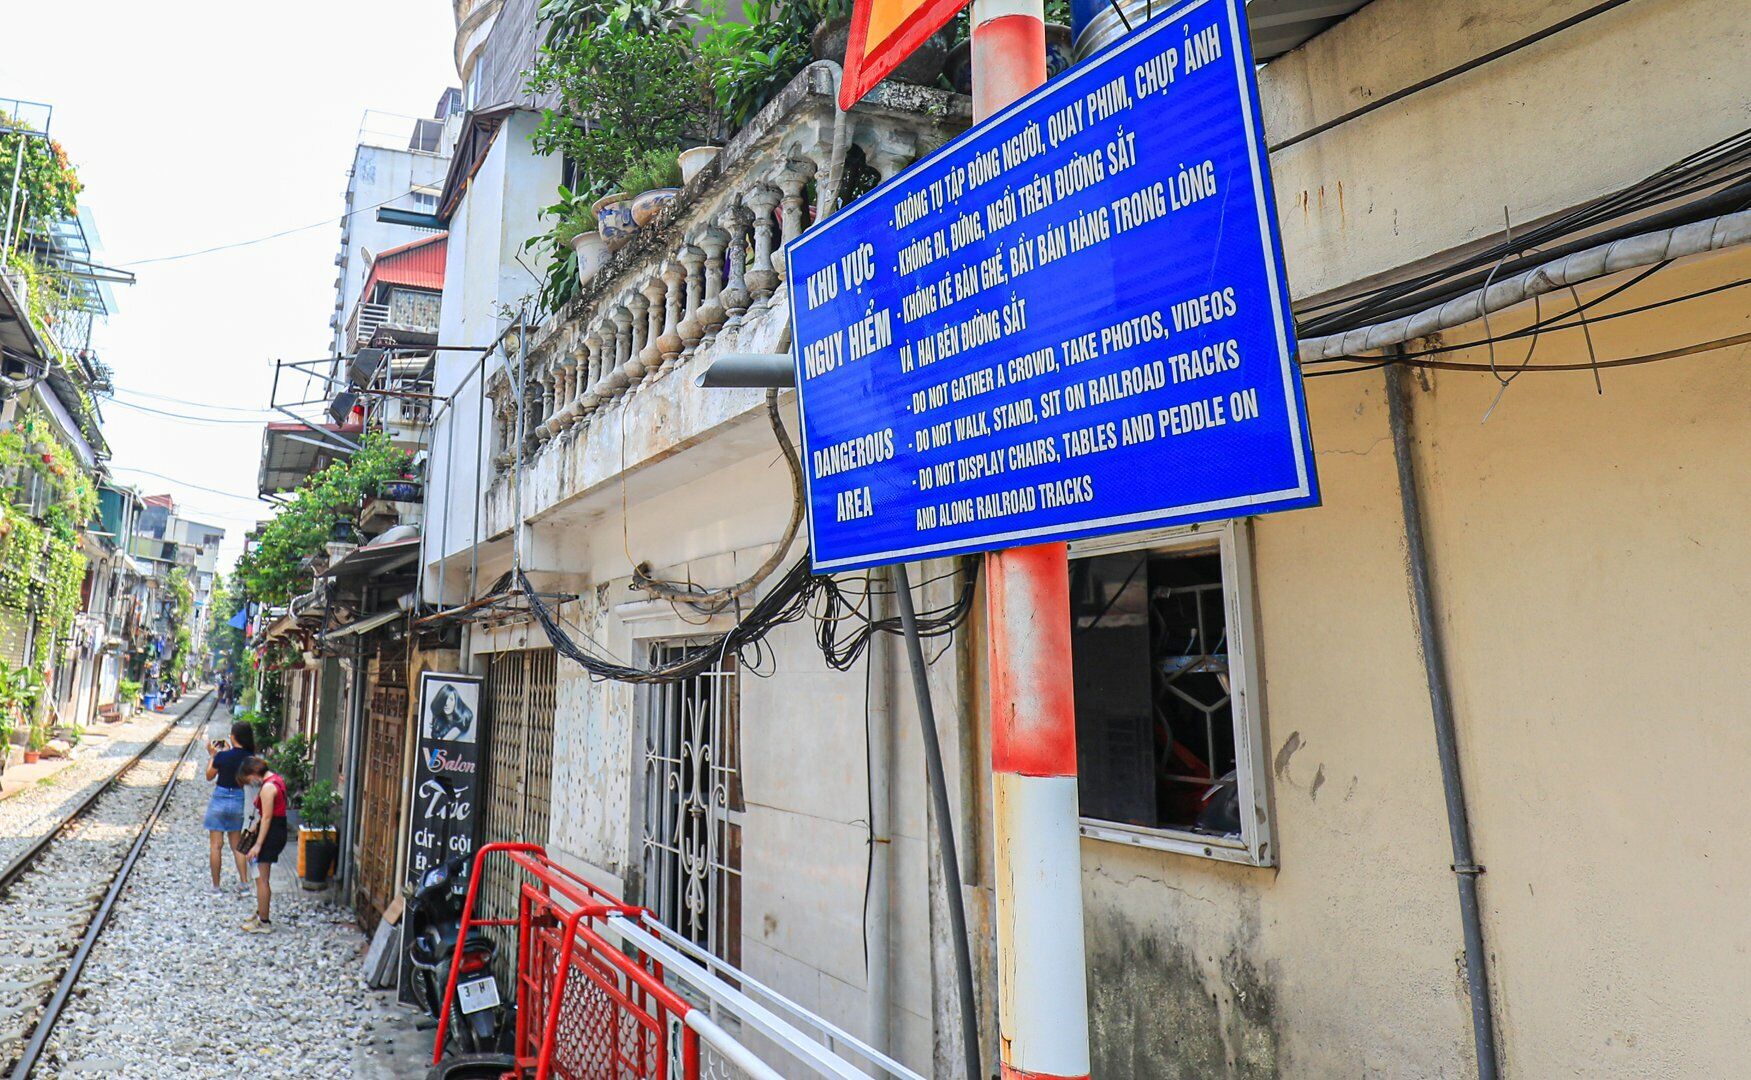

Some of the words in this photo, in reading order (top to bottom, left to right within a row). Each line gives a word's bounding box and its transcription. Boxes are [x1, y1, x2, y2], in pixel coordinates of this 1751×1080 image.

[894, 188, 929, 231] KHÔNG
[929, 179, 944, 214] TỤ
[944, 165, 966, 206] TẬP
[967, 147, 1001, 191] ĐÔNG
[1001, 119, 1046, 172] NGƯỜI,
[1047, 98, 1084, 149] QUAY
[1086, 75, 1133, 126] PHIM,
[1134, 47, 1178, 100] CHỤP
[1183, 22, 1222, 75] ẢNH
[898, 235, 933, 278] KHÔNG
[933, 228, 950, 260] ĐI,
[950, 210, 986, 252] ĐỨNG,
[986, 184, 1017, 234] NGỒI
[1017, 173, 1054, 218] TRÊN
[1054, 149, 1105, 201] ĐƯỜNG
[1106, 124, 1136, 176] SẮT
[902, 283, 938, 324] KHÔNG
[938, 271, 954, 309] KÊ
[954, 263, 979, 302] BÀN
[980, 242, 1009, 291] GHẾ,
[1009, 232, 1034, 278] BẦY
[1036, 223, 1067, 267] BÁN
[1068, 206, 1111, 254] HÀNG
[1111, 181, 1167, 234] TRONG
[1168, 159, 1217, 212] LÒNG
[806, 262, 839, 311] KHU
[841, 242, 875, 295] VỰC
[803, 329, 844, 381] NGUY
[848, 298, 892, 362] HIỂM
[899, 338, 914, 374] VÀ
[917, 335, 936, 368] HAI
[936, 322, 960, 361] BÊN
[960, 308, 1001, 352] ĐƯỜNG
[1002, 290, 1027, 336] SẮT
[912, 390, 927, 415] DO
[927, 382, 949, 410] NOT
[950, 367, 995, 403] GATHER
[997, 363, 1007, 389] A
[1007, 346, 1060, 384] CROWD,
[1060, 331, 1099, 367] TAKE
[1100, 310, 1169, 355] PHOTOS,
[1170, 286, 1237, 333] VIDEOS
[915, 428, 930, 453] DO
[931, 421, 952, 449] NOT
[954, 410, 991, 442] WALK,
[992, 398, 1038, 432] STAND,
[1040, 389, 1061, 419] SIT
[1064, 382, 1086, 412] ON
[1087, 360, 1166, 406] RAILROAD
[1168, 338, 1240, 384] TRACKS
[918, 466, 933, 491] DO
[934, 460, 955, 488] NOT
[957, 448, 1005, 483] DISPLAY
[1008, 436, 1061, 471] CHAIRS,
[1062, 421, 1118, 459] TABLES
[1122, 413, 1155, 447] AND
[1158, 395, 1226, 438] PEDDLE
[1229, 387, 1259, 422] ON
[813, 427, 895, 480] DANGEROUS
[837, 485, 874, 523] AREA
[916, 505, 937, 531] AND
[939, 498, 975, 527] ALONG
[976, 486, 1036, 520] RAILROAD
[1037, 474, 1094, 509] TRACKS
